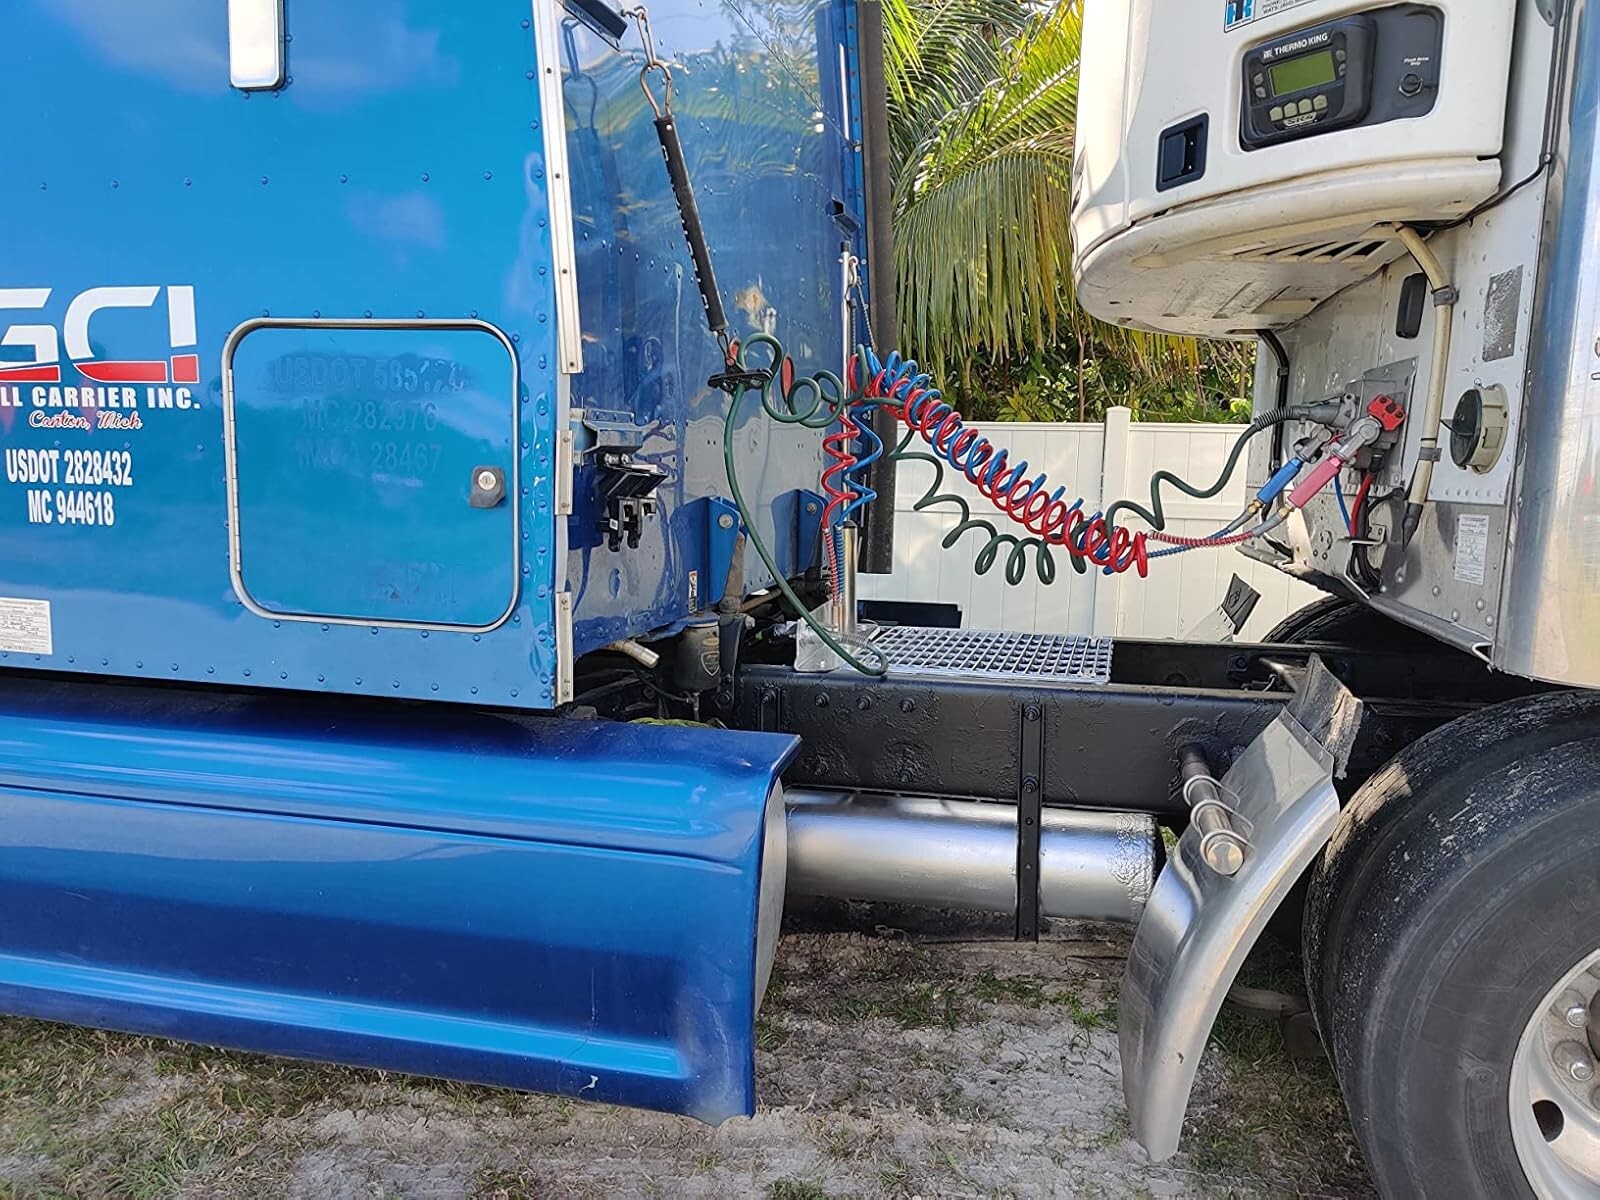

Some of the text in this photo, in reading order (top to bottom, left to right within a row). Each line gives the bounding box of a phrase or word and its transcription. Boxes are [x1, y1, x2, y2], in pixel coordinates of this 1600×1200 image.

[1274, 39, 1308, 55] THERMO
[1308, 32, 1328, 45] KING
[31, 386, 137, 408] CARRIER
[147, 387, 200, 410] INC.
[29, 409, 143, 431] Canton, Mich
[6, 448, 133, 486] USDOT 2828432
[27, 489, 115, 526] MC 944618
